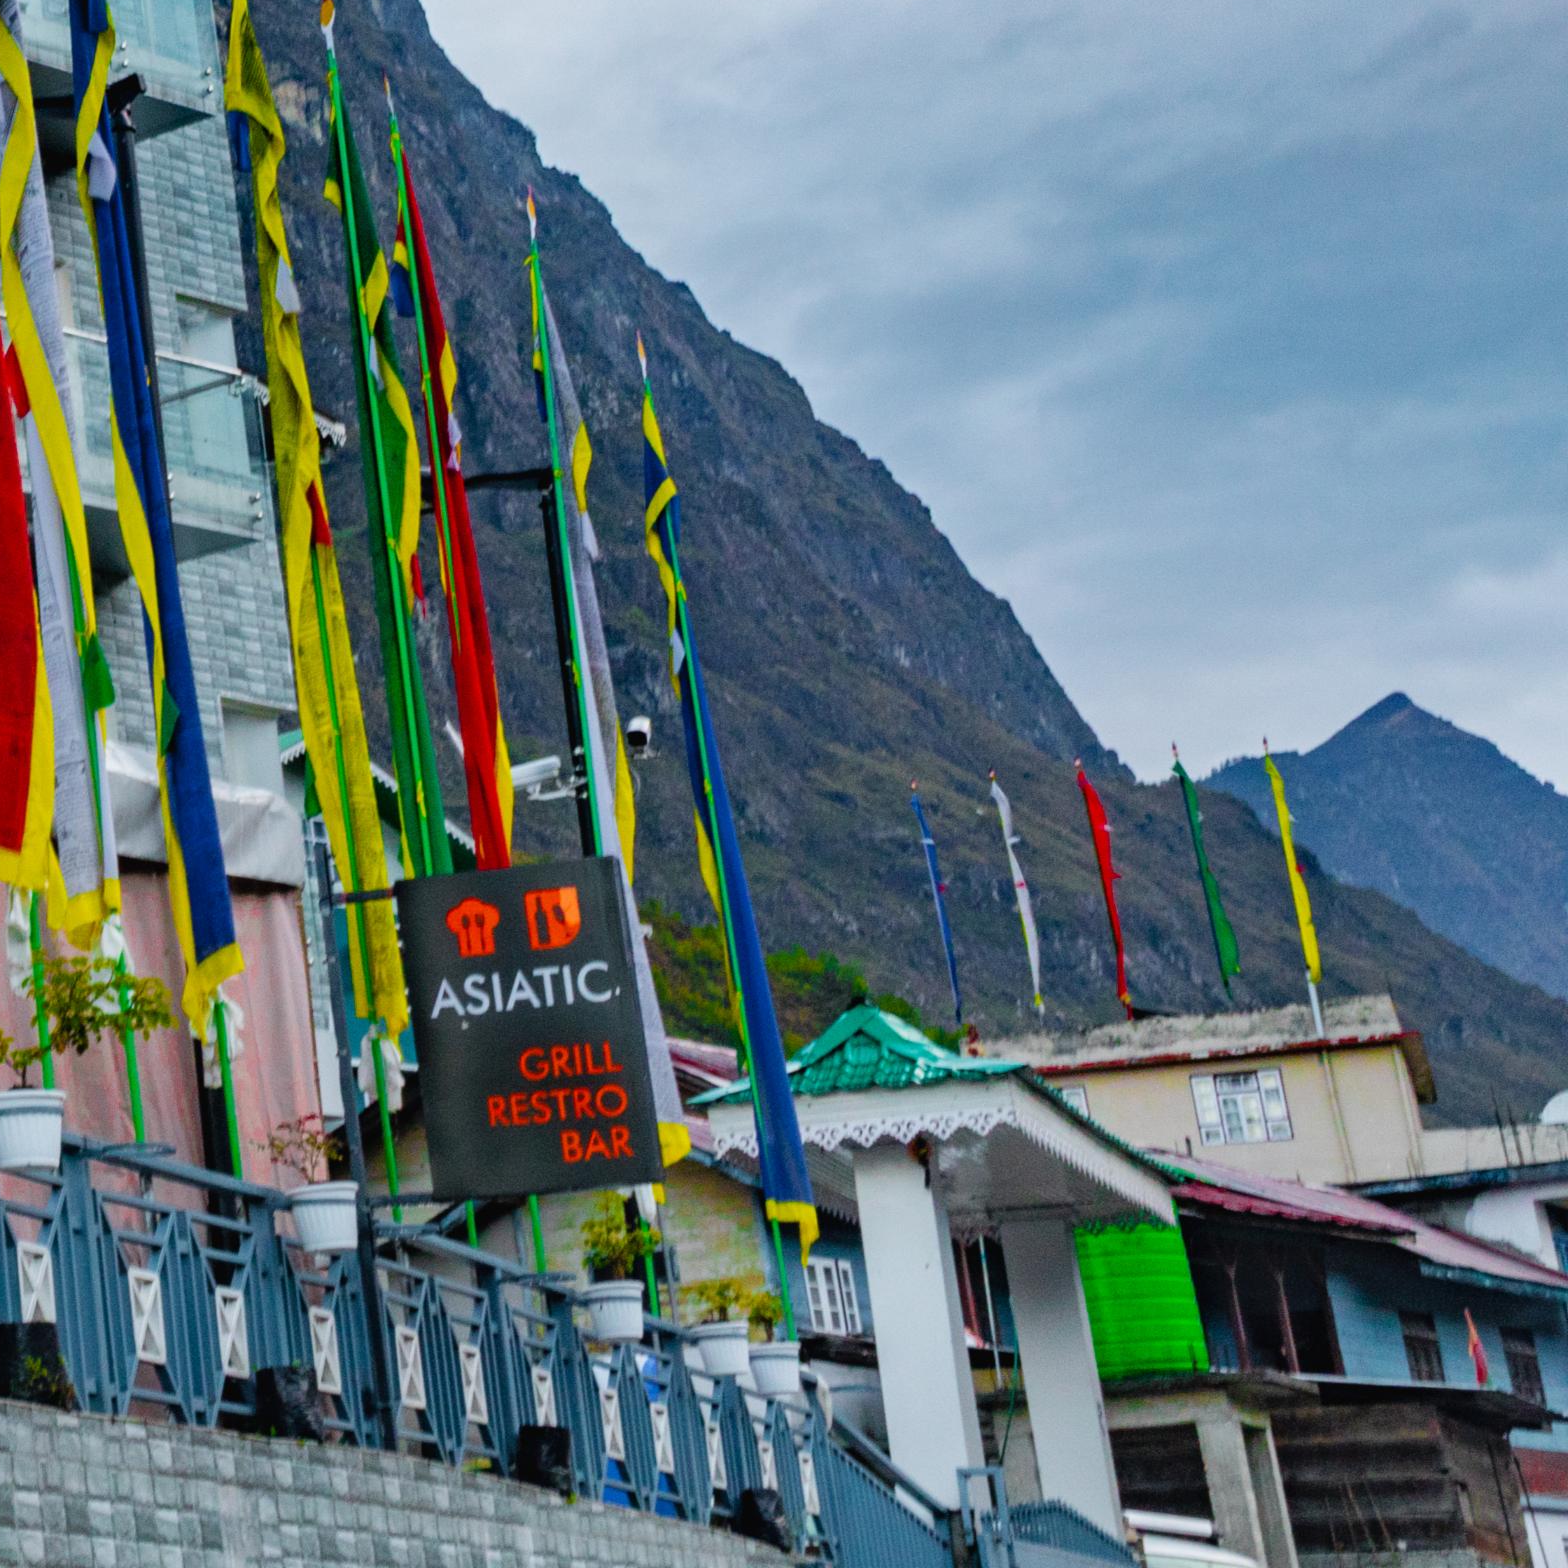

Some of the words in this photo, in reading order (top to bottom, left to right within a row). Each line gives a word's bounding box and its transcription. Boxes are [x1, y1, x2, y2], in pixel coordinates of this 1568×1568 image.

[431, 961, 612, 1019] ASIATIC
[519, 1040, 623, 1083] GRILL
[487, 1084, 629, 1128] RESTRO
[560, 1124, 634, 1164] BAR
